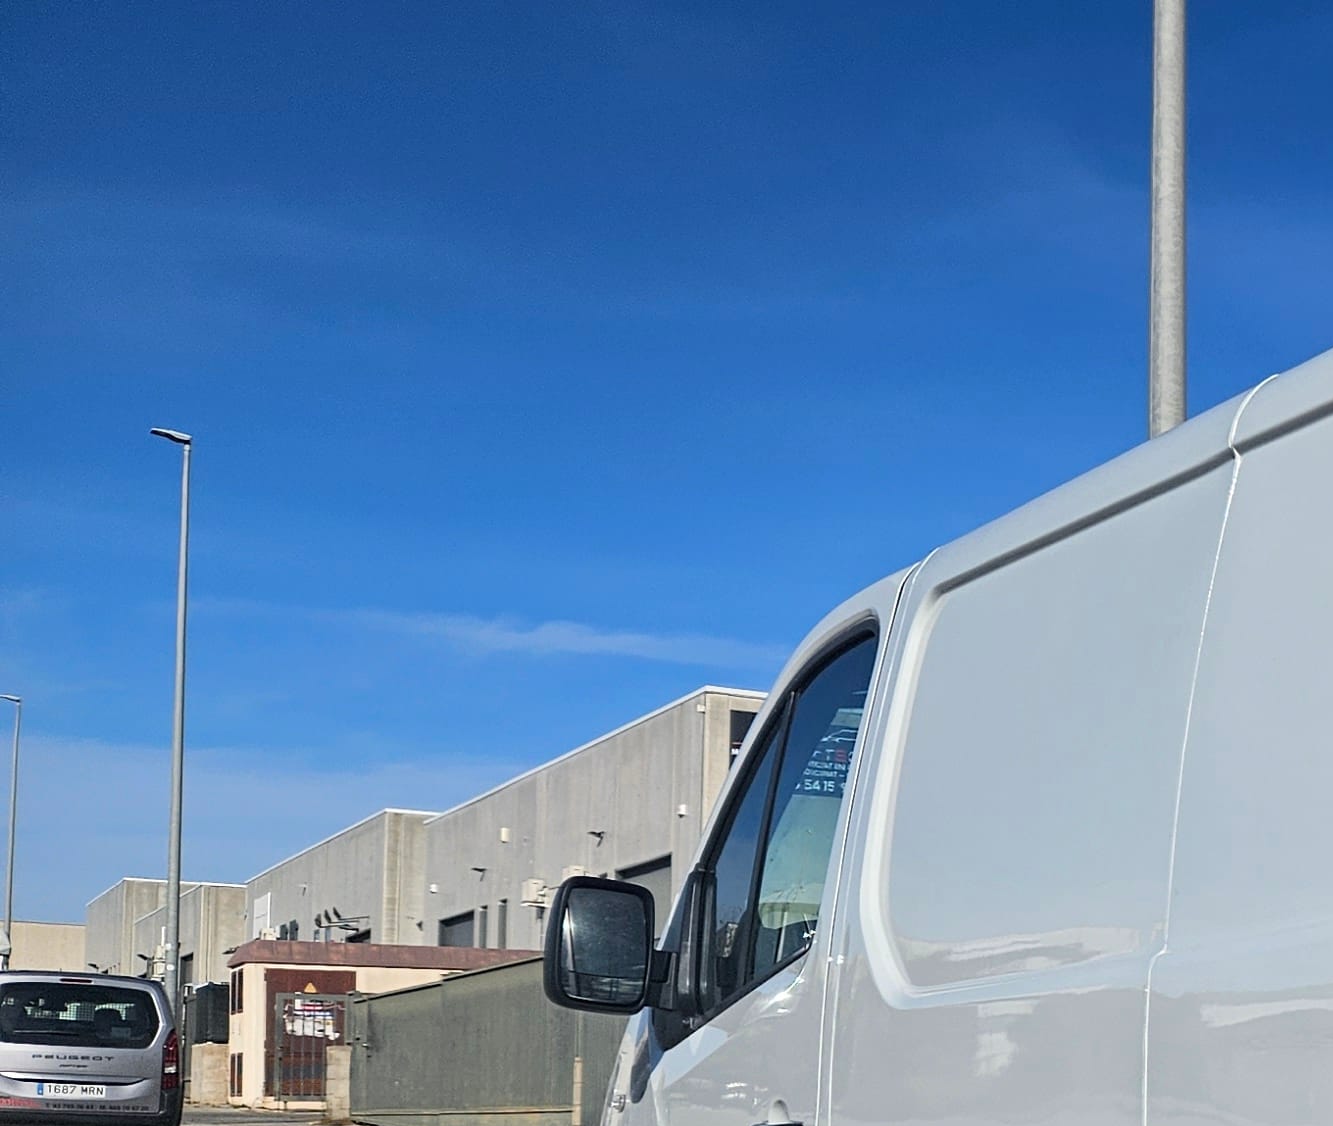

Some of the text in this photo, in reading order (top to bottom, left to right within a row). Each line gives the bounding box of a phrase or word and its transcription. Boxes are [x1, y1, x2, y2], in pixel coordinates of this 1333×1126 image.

[31, 1053, 115, 1062] PEUGEOT
[47, 1084, 104, 1096] 1687 MRN
